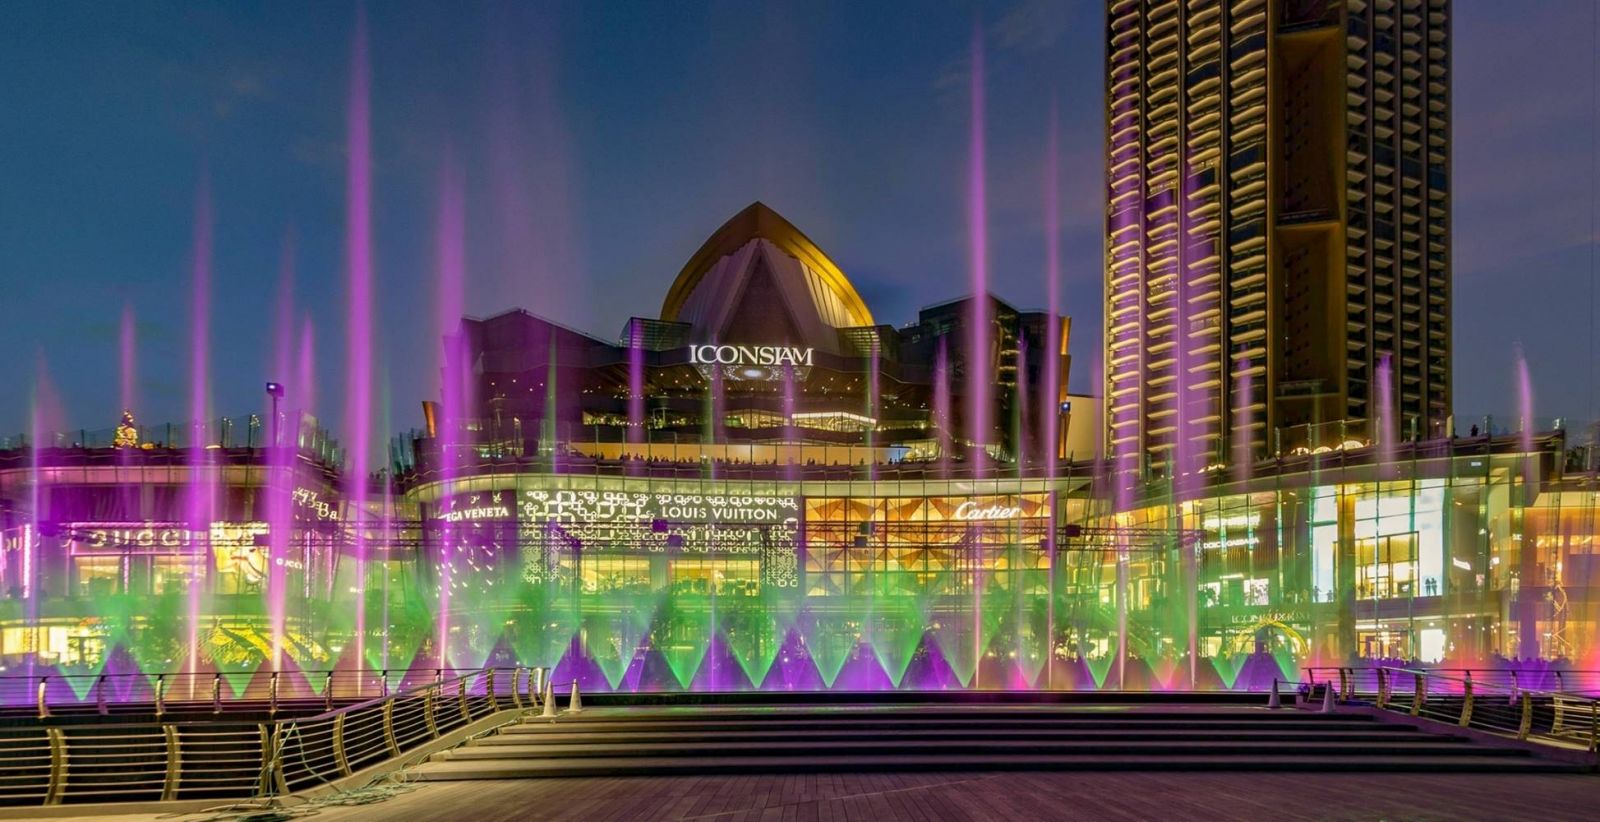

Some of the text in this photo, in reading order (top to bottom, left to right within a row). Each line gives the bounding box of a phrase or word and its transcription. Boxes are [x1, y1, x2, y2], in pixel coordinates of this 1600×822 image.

[689, 344, 814, 366] ICONSIAM
[464, 507, 509, 519] VENETA
[662, 506, 777, 519] LOUIS VUITTON
[956, 501, 1021, 520] Cartier
